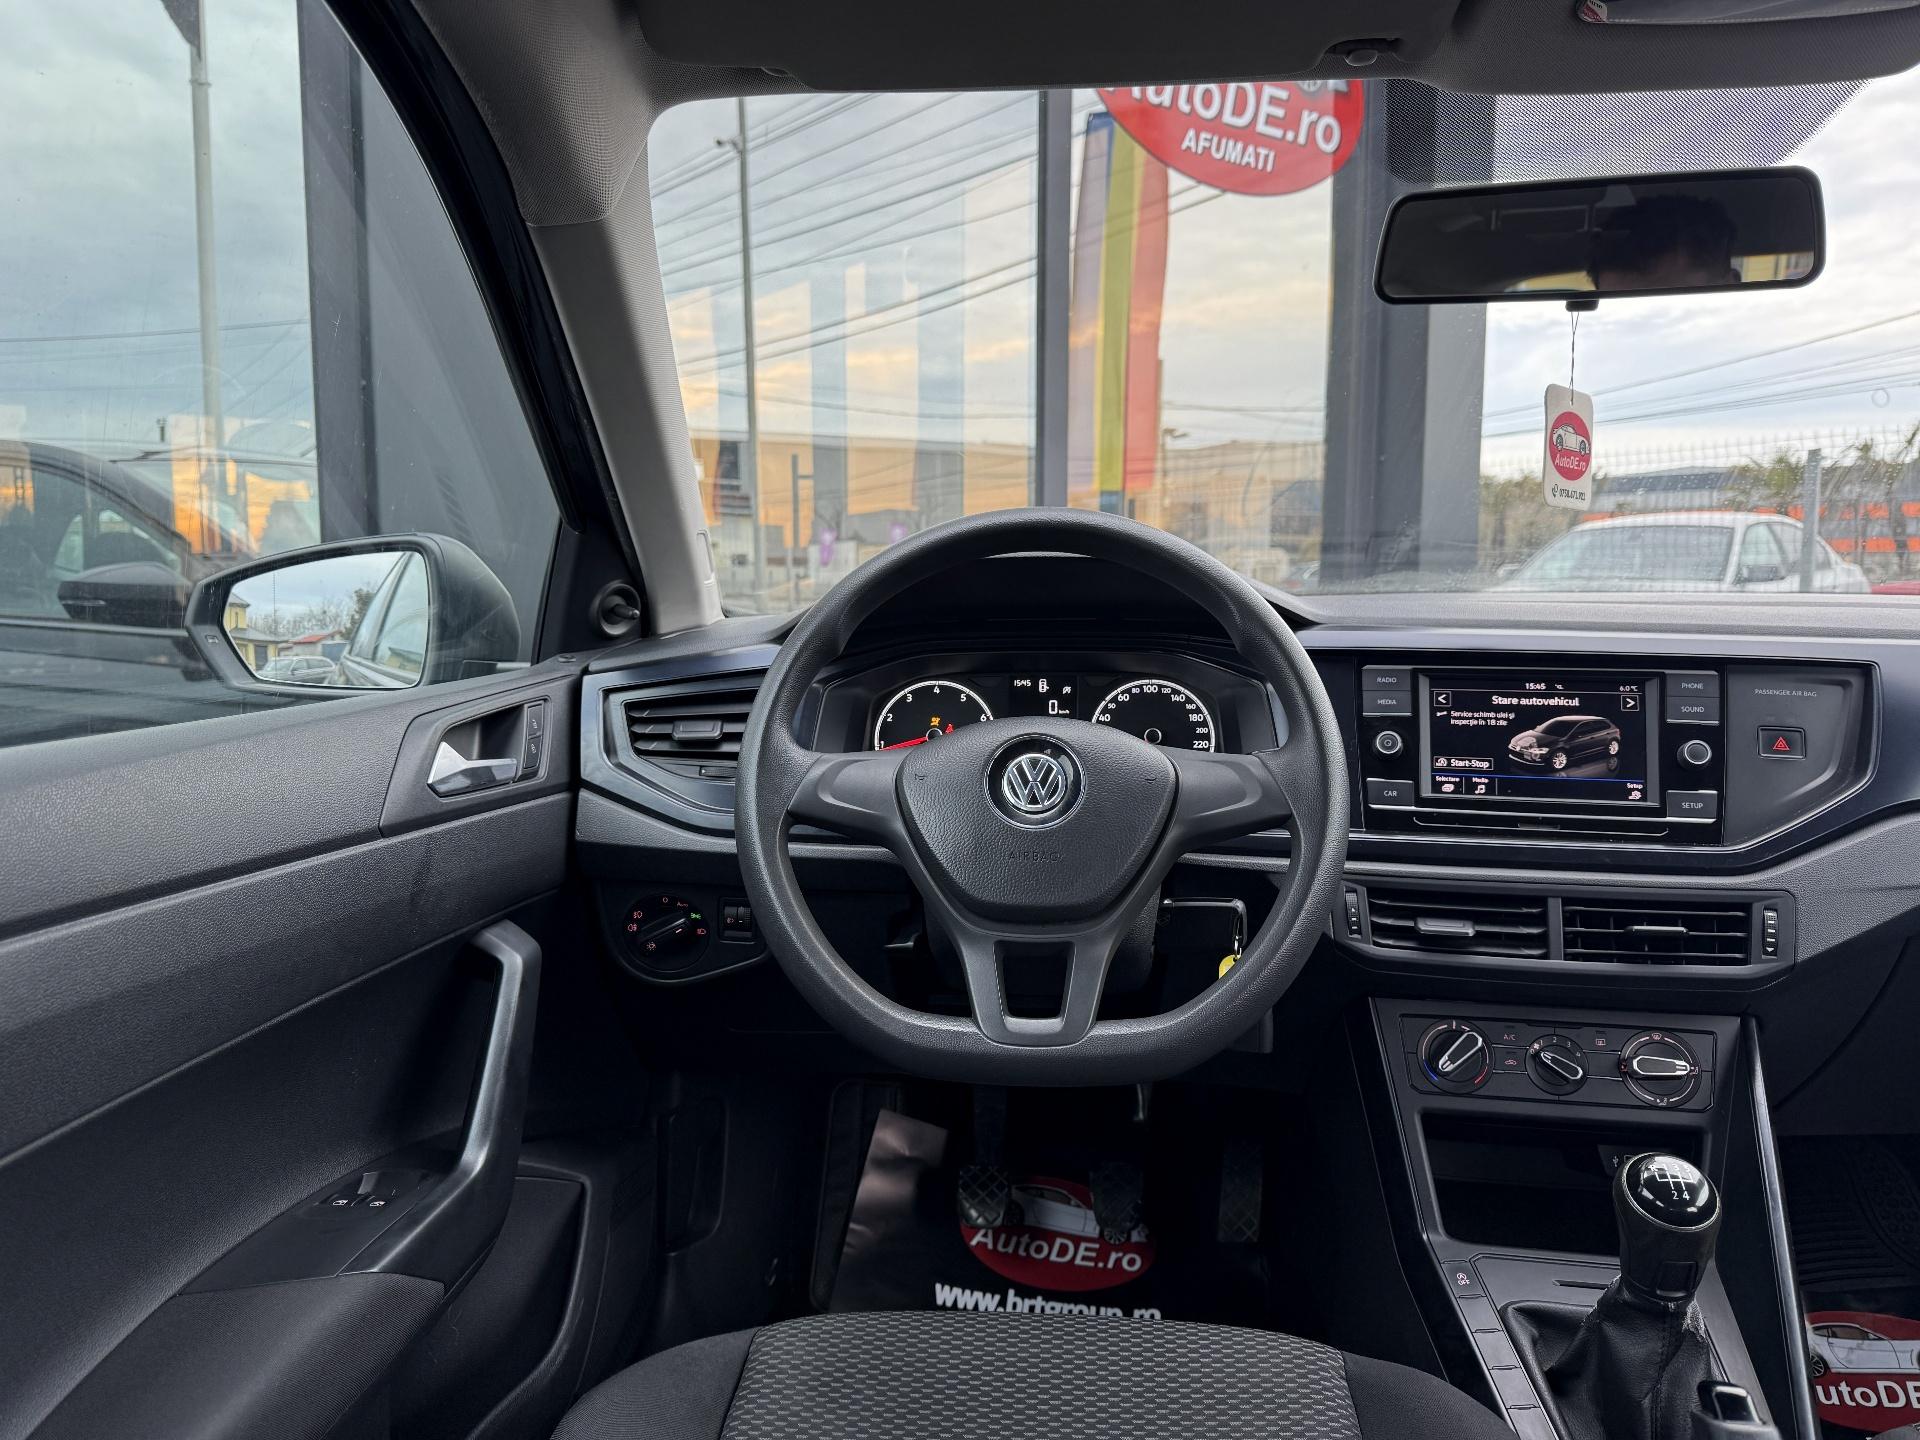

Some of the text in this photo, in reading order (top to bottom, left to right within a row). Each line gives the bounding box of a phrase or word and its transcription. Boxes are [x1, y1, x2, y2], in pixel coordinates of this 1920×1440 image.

[1181, 129, 1275, 172] AFUMATI
[1555, 454, 1586, 471] AutoDE.ro
[933, 686, 940, 694] 4
[1143, 685, 1158, 693] 100
[1754, 688, 1791, 696] PASSENGER
[906, 694, 912, 702] 3
[960, 694, 966, 702] 5
[1171, 694, 1185, 702] 140
[1492, 695, 1580, 706] Stare autovehicul
[1049, 700, 1058, 714] 0
[887, 714, 893, 722] 2
[980, 714, 986, 722] 6
[1189, 714, 1203, 722] 180
[1450, 759, 1489, 769] Start-Stop
[1671, 1191, 1690, 1200] 2 4
[970, 1228, 1142, 1272] AutoDE.ro
